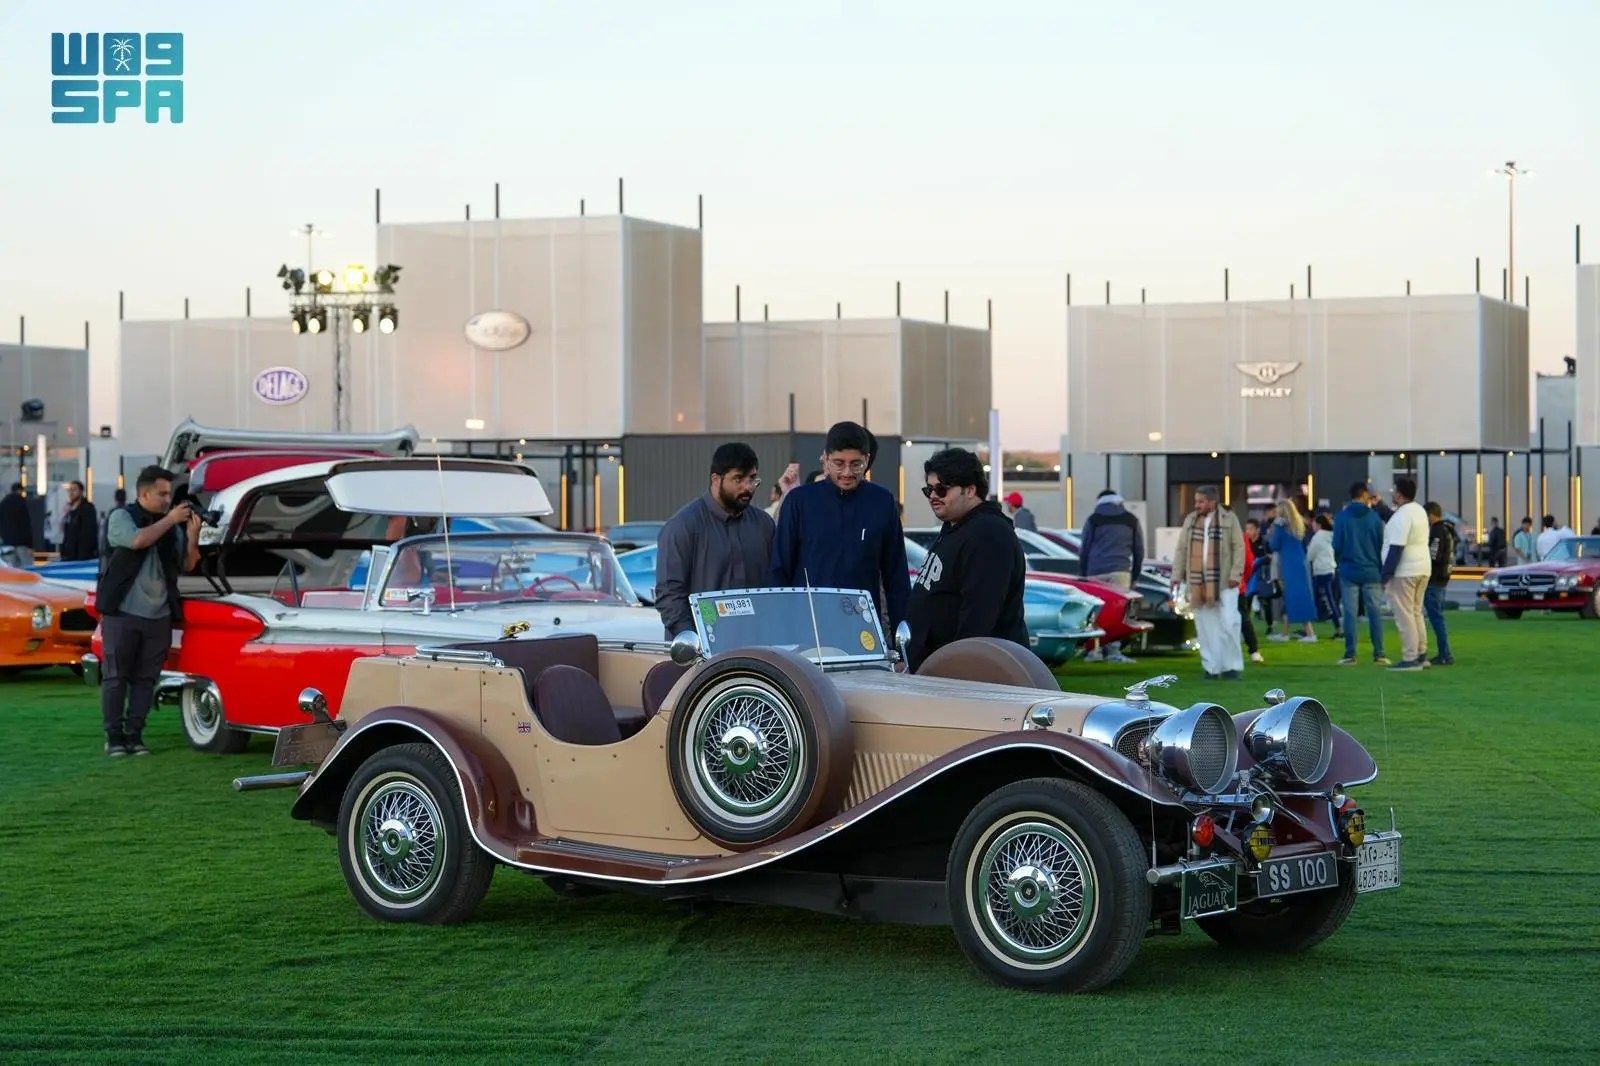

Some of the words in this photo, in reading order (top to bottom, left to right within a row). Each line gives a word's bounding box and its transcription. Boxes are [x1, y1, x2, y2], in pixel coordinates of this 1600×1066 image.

[1268, 863, 1291, 892] SS
[1298, 857, 1327, 888] 100
[1187, 890, 1228, 915] JAGUAR
